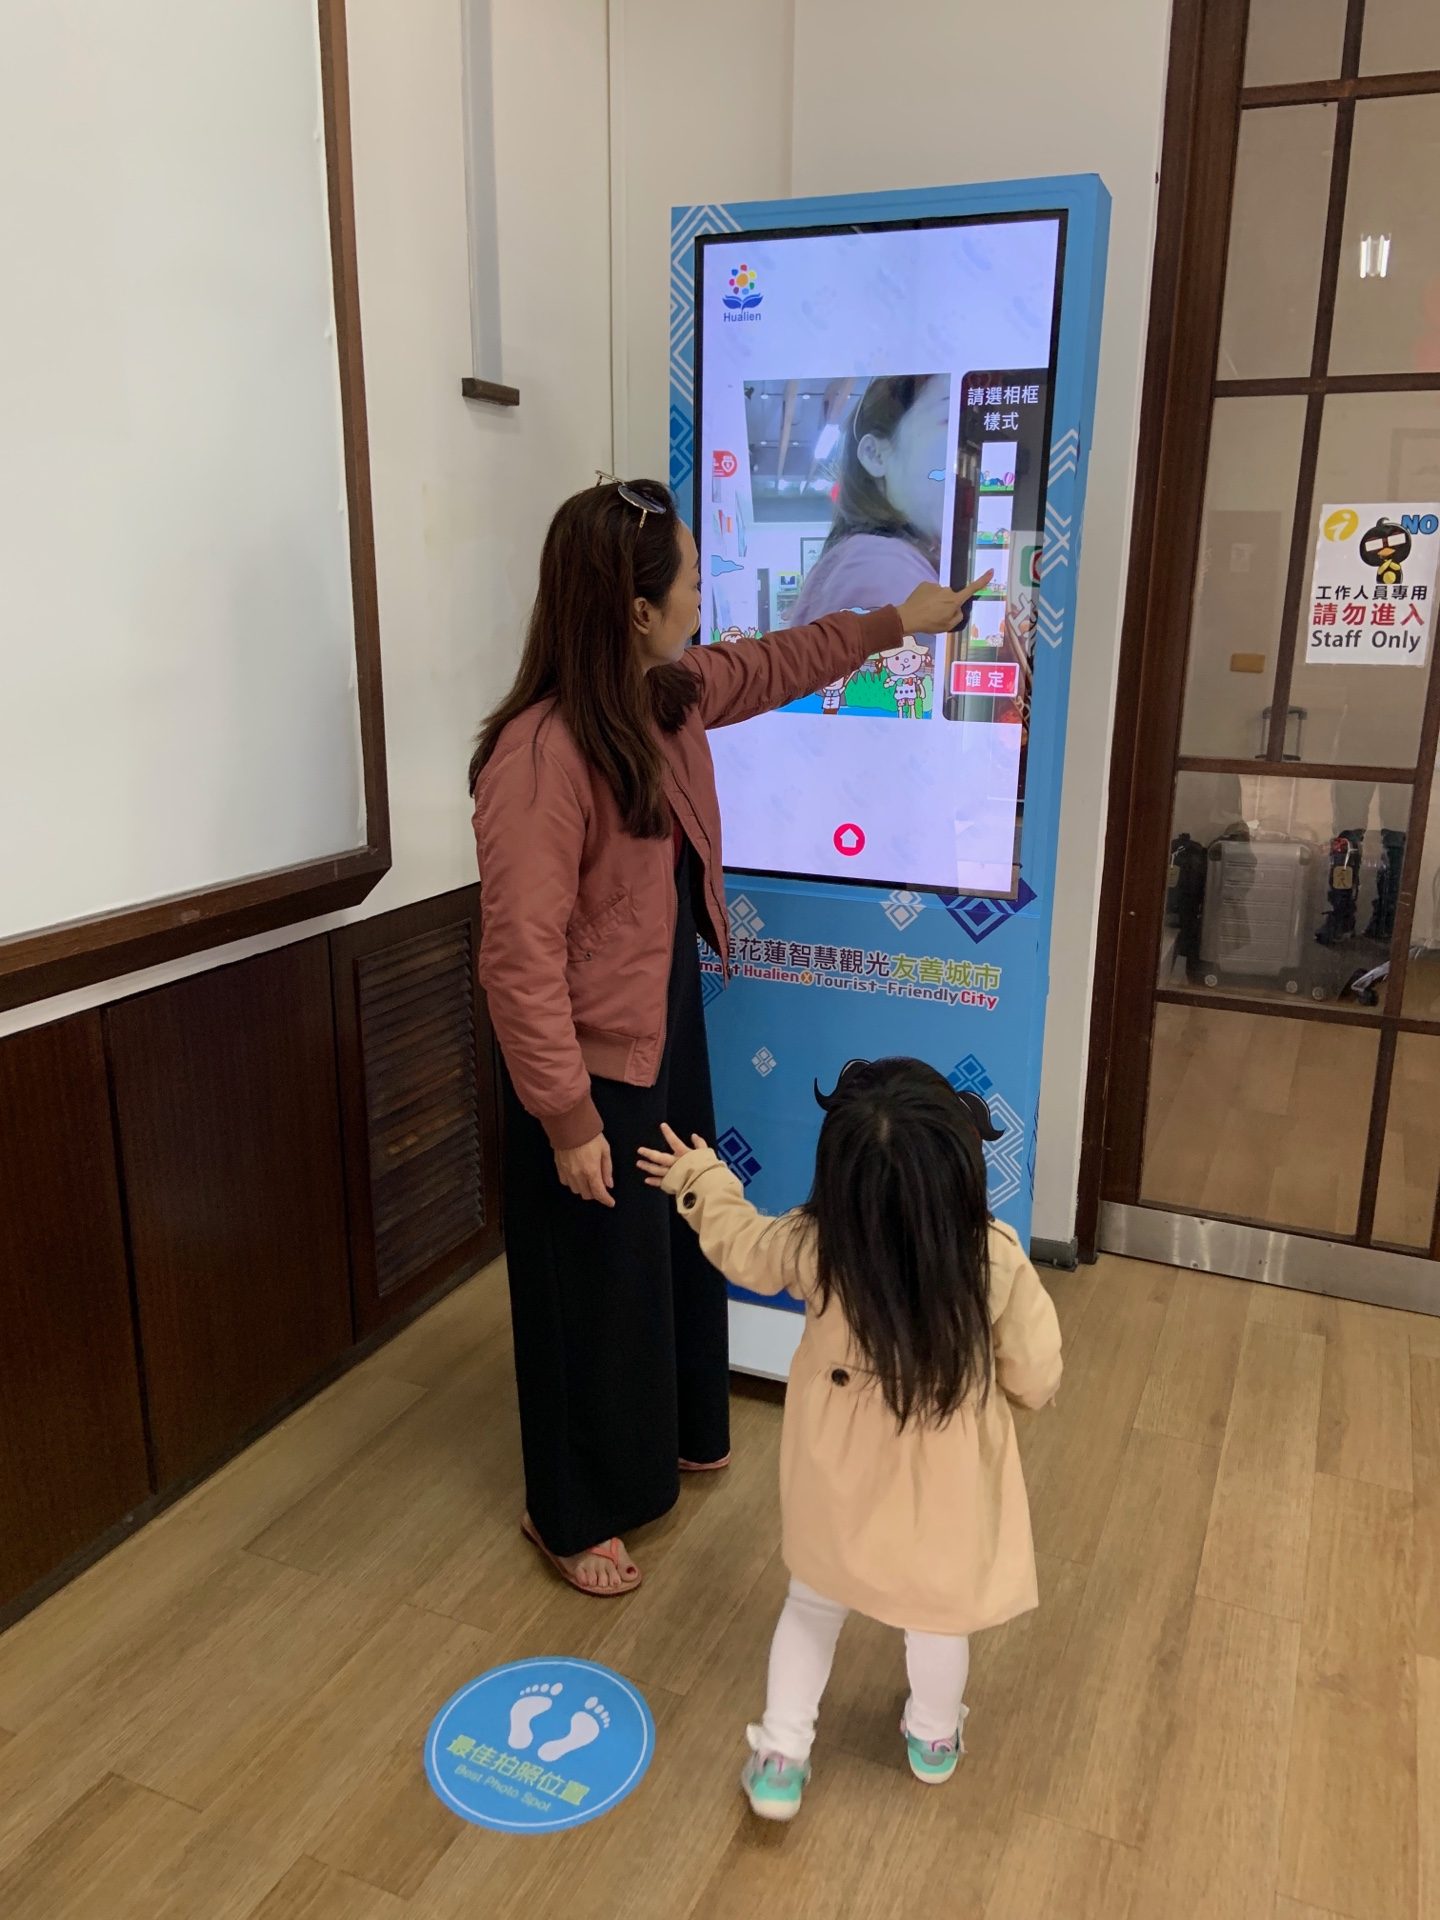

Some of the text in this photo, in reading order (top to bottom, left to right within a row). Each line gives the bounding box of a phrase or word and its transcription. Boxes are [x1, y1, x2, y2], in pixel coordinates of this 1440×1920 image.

[723, 310, 762, 323] Hualien
[967, 385, 1039, 406] 請選相框
[983, 411, 1019, 431] 樣式
[1400, 514, 1439, 535] NO
[1315, 585, 1428, 601] 工作人員專用
[1312, 603, 1425, 626] 請勿進入
[1311, 629, 1421, 653] Staff Only
[964, 669, 1004, 689] 確定
[699, 960, 741, 976] mat
[743, 963, 800, 984] Hualien
[814, 972, 960, 1006] Tourist-Friendly
[960, 990, 999, 1011] City
